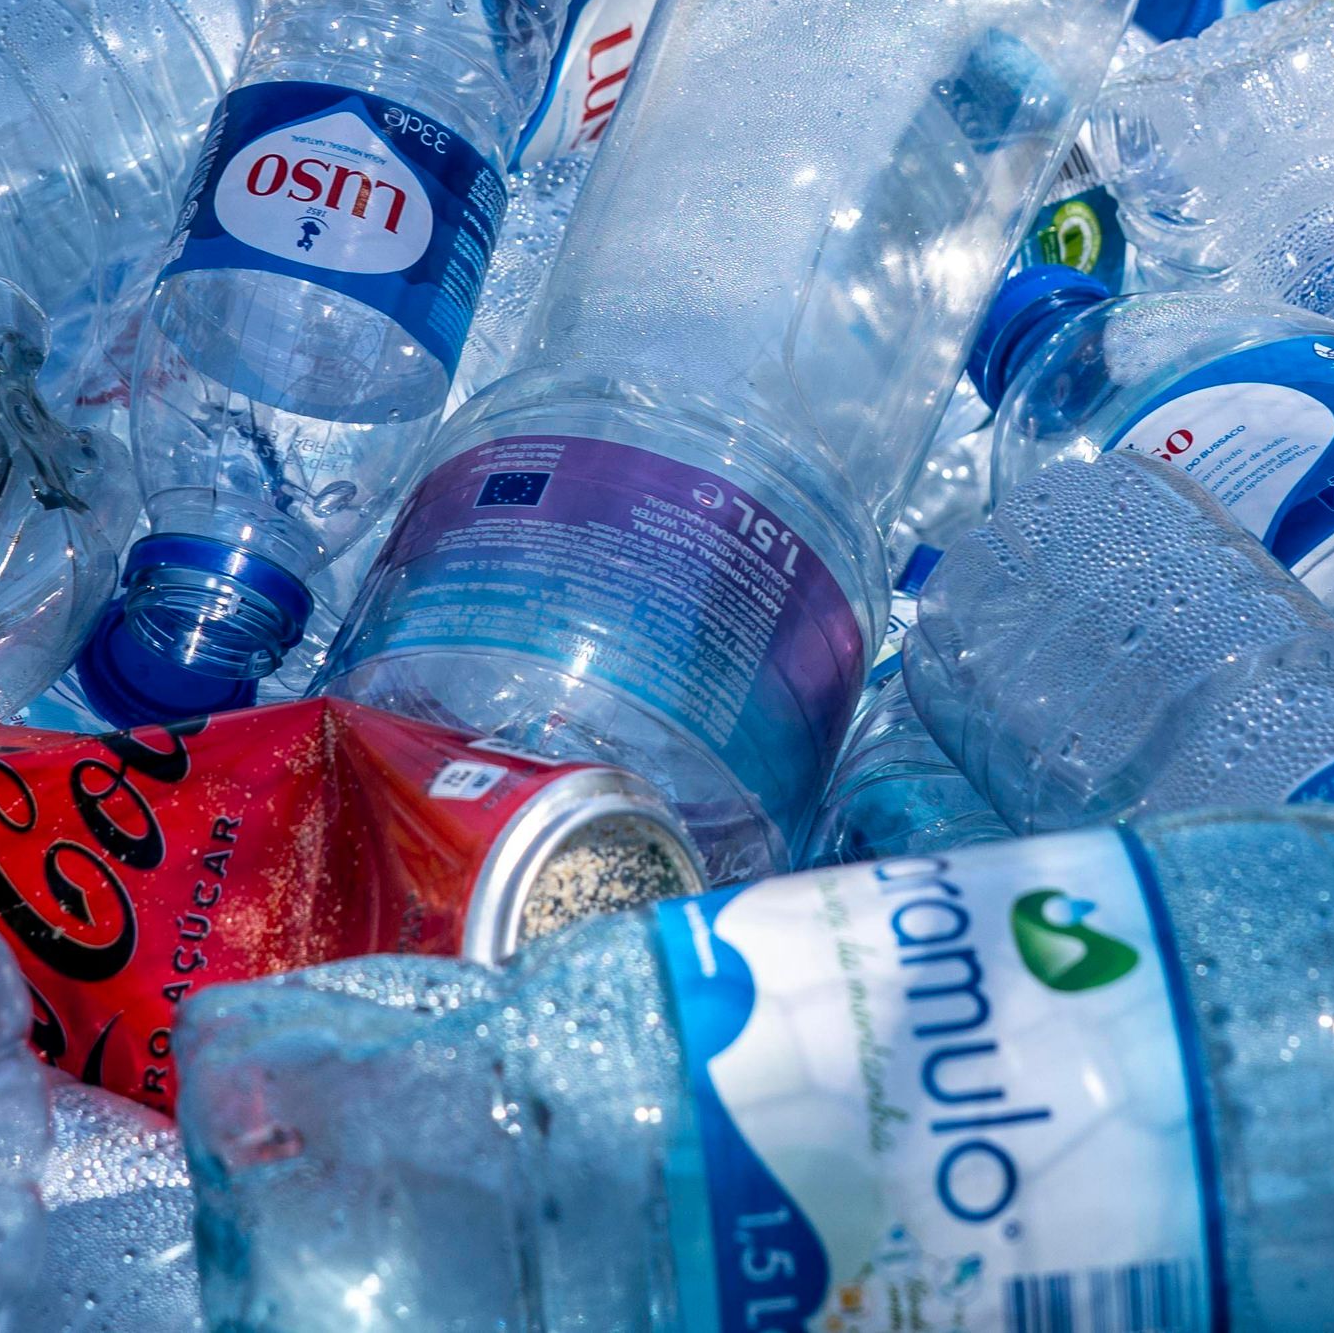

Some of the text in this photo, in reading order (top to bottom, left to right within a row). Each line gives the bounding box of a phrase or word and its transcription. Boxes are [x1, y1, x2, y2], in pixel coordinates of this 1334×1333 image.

[570, 22, 633, 150] LUS
[290, 134, 362, 156] MINERAL NATURAL
[244, 148, 407, 233] LUSO
[304, 204, 327, 218] 1852
[1184, 422, 1247, 472] DO BUSSACO
[1199, 445, 1245, 483] arrafada.
[1231, 442, 1301, 492] alimentos para
[1209, 473, 1230, 493] aixo
[1227, 459, 1248, 477] teor
[1248, 449, 1261, 462] de
[642, 495, 707, 526] NATURAL
[628, 517, 697, 551] NATURAL
[628, 502, 788, 604] NATURAL MINERAL WATER
[705, 518, 761, 564] MINERAL
[732, 496, 800, 577] 1,5L
[693, 543, 751, 589] MINERAL
[653, 586, 687, 612] Local
[695, 610, 727, 638] Place
[730, 639, 762, 669] Local
[160, 814, 244, 1021] AÇÚCAR
[873, 853, 1052, 1223] aramulo
[739, 1202, 793, 1284] 1,5
